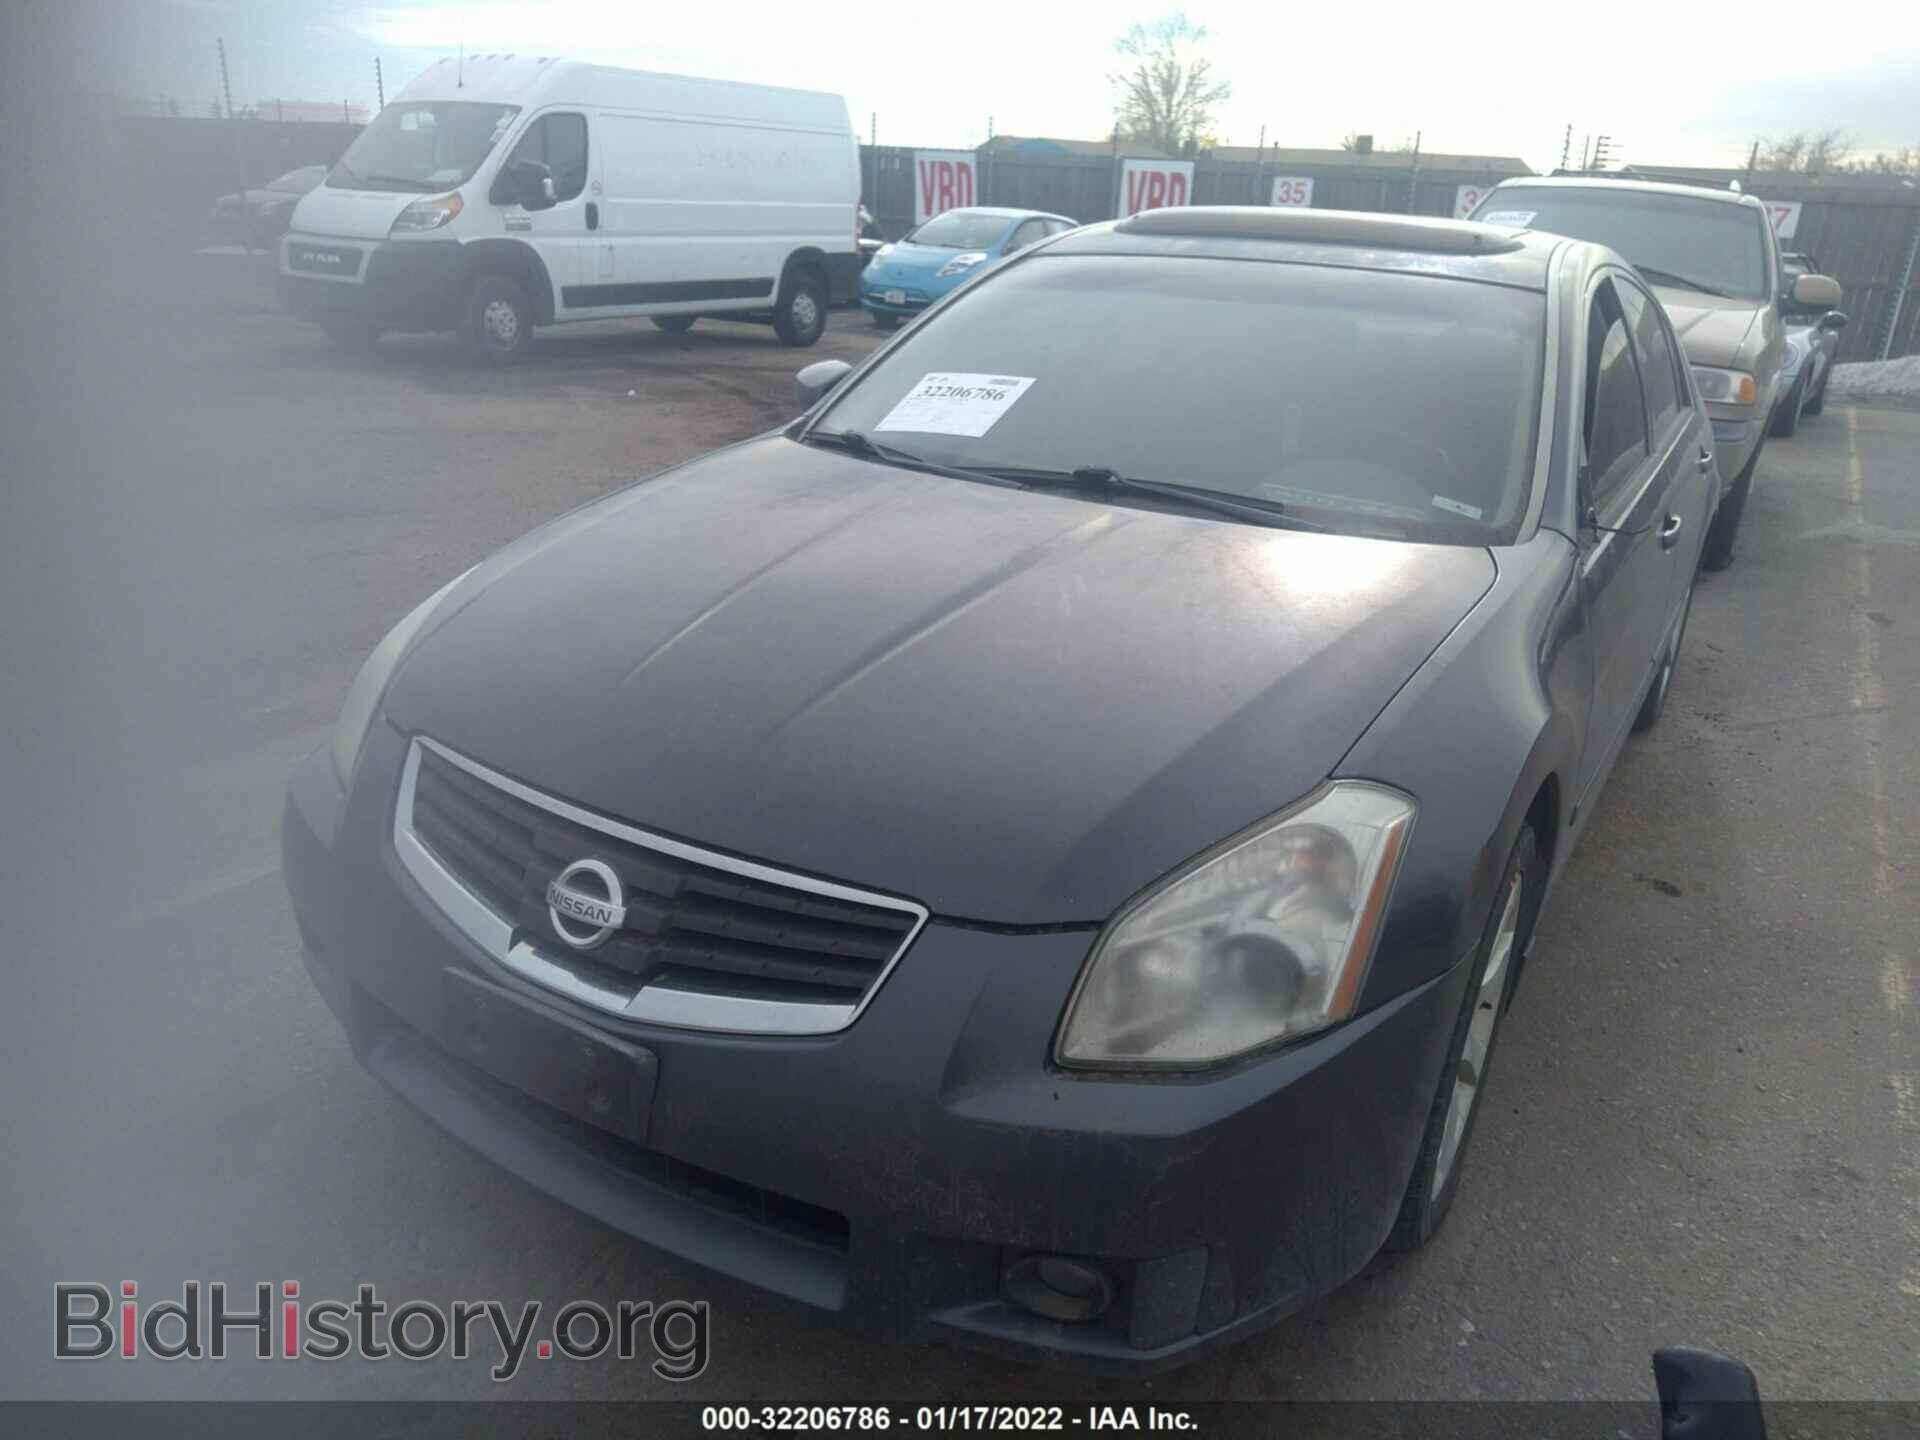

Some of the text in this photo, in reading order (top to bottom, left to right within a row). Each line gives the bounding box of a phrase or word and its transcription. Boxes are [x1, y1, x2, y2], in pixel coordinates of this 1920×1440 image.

[1279, 181, 1306, 204] 35
[1766, 207, 1792, 230] 7
[917, 385, 1009, 401] 32206786
[551, 888, 612, 924] NISSAN
